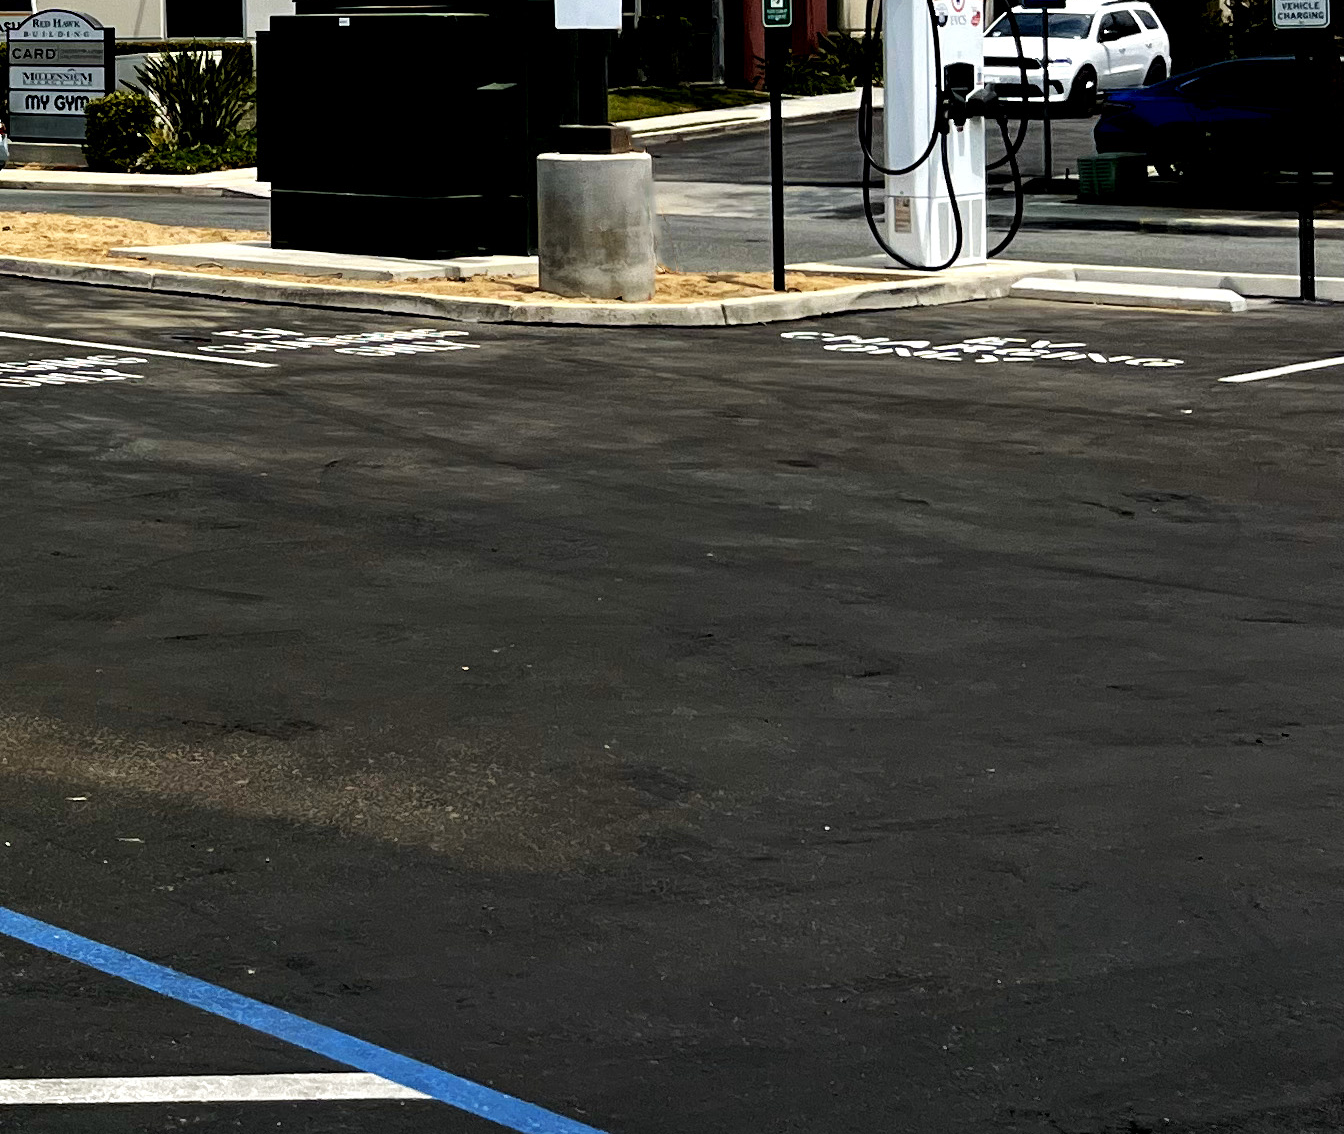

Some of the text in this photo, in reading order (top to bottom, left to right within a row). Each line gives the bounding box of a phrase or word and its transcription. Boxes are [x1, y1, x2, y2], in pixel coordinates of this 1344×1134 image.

[1282, 2, 1320, 10] VEHICLE
[1277, 11, 1325, 20] CHARGING
[12, 48, 56, 60] CARD
